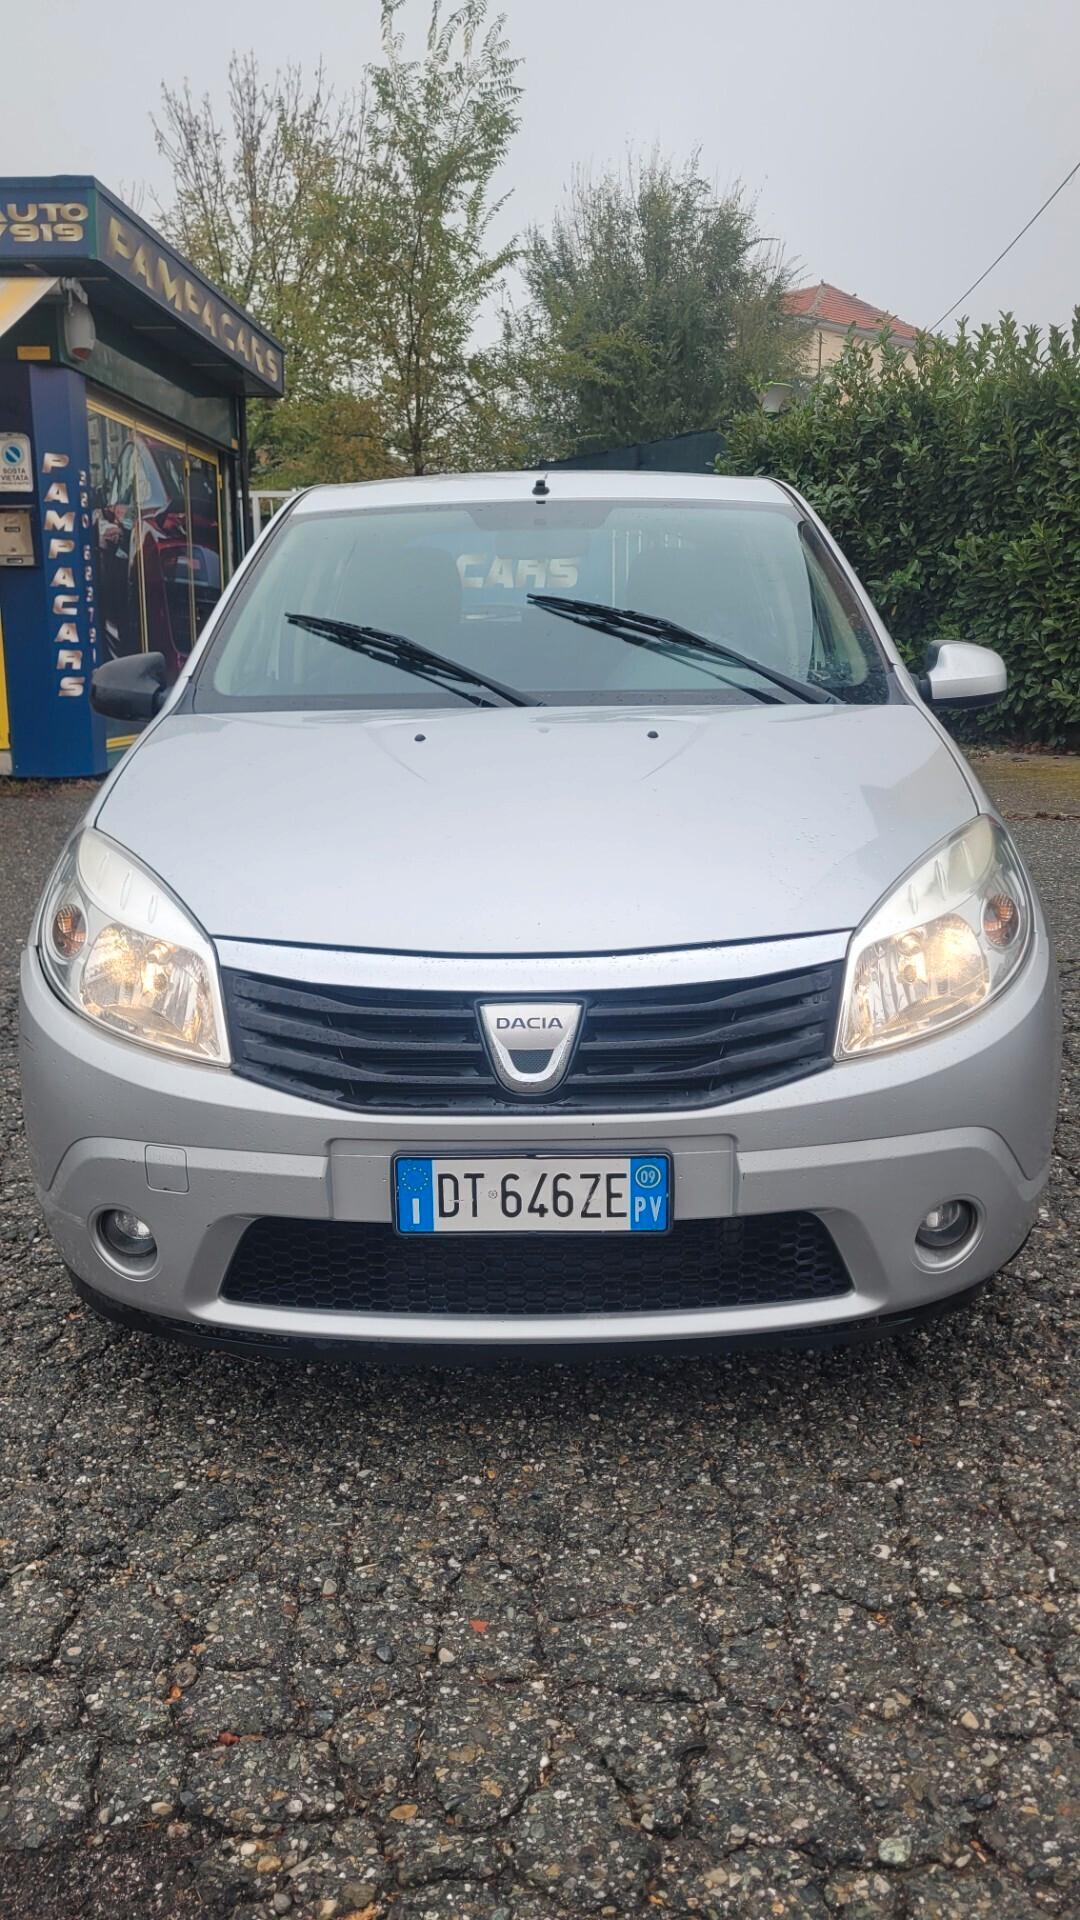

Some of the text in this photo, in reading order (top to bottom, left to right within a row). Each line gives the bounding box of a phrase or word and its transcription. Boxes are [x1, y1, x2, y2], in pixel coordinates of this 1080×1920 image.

[42, 452, 86, 697] PAMPACARS
[456, 554, 579, 588] CARS
[496, 1017, 563, 1029] DACIA
[640, 1171, 656, 1183] 09
[437, 1173, 627, 1218] DT 646ZE
[412, 1198, 420, 1224] I
[634, 1196, 662, 1222] PV
